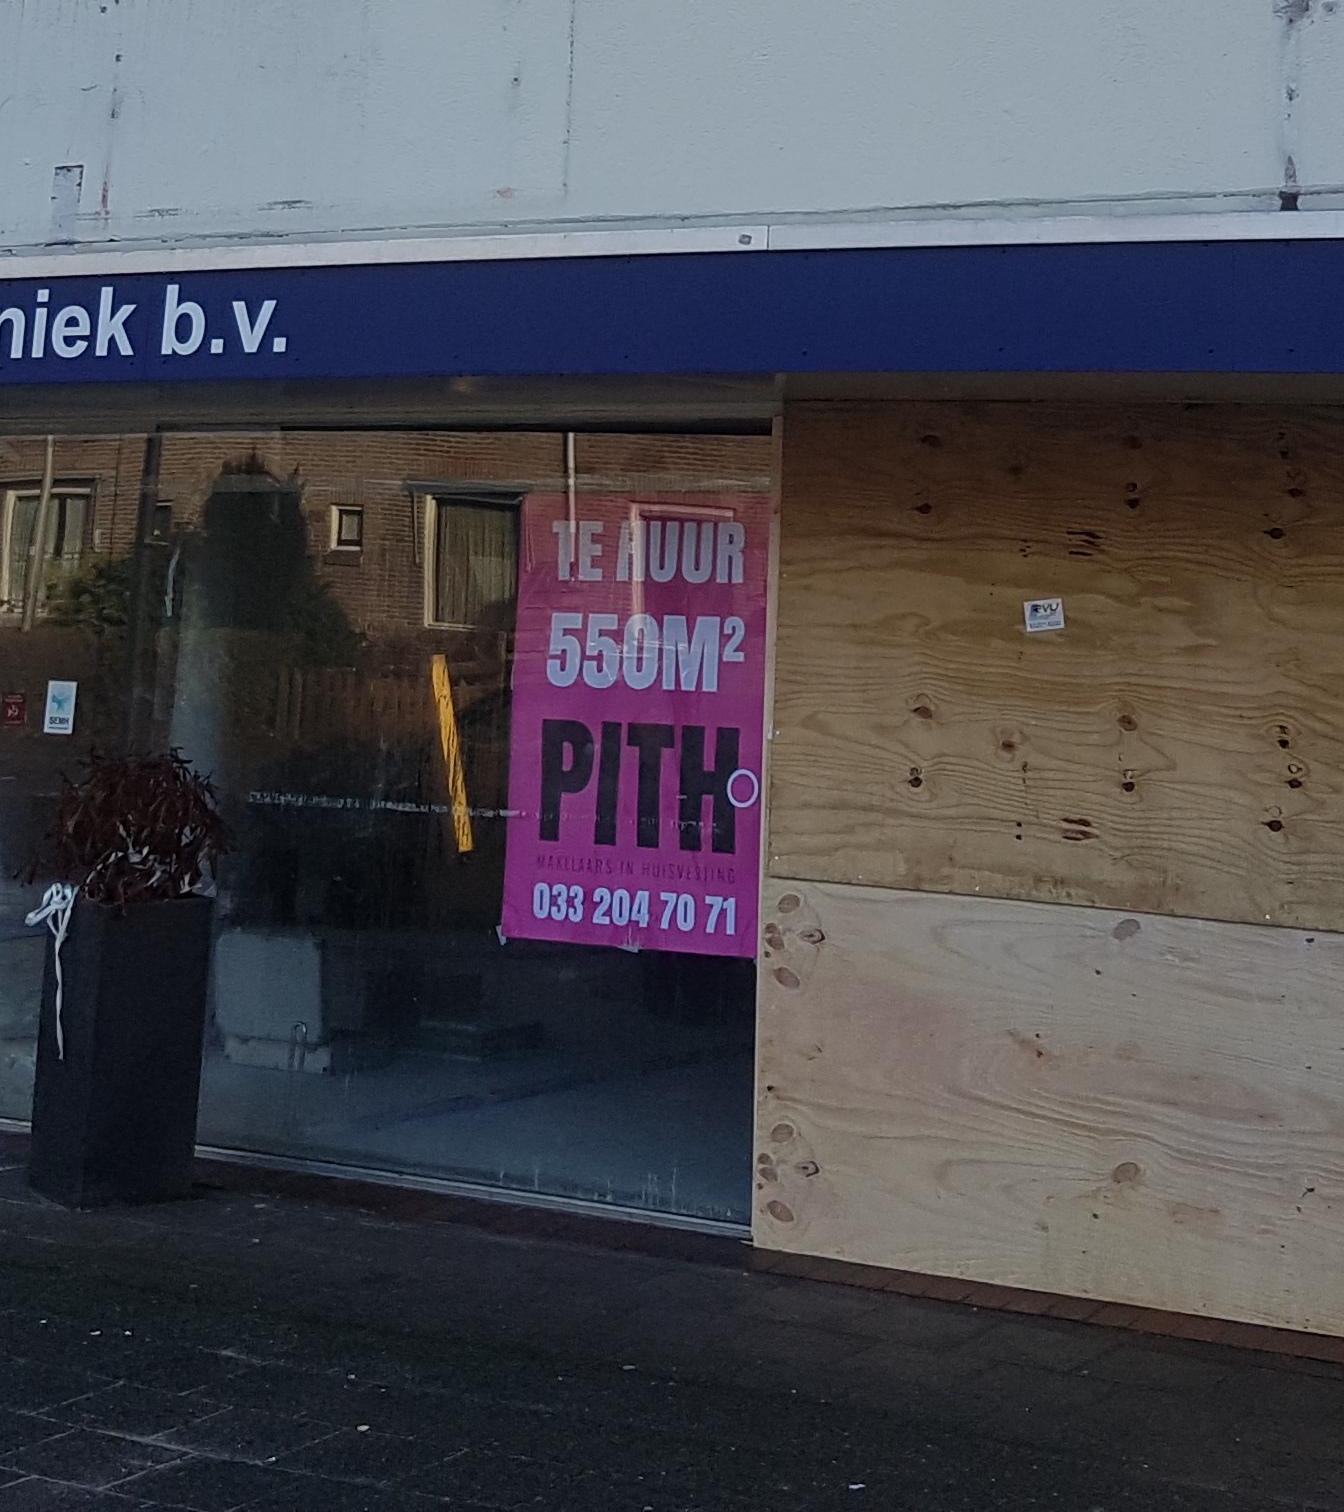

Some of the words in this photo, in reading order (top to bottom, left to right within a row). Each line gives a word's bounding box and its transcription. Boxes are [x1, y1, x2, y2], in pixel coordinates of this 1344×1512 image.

[159, 285, 289, 356] b.v.
[552, 520, 604, 582] TE
[616, 520, 746, 584] HUUR
[539, 718, 740, 855] PITH
[532, 882, 584, 923] 033
[592, 887, 650, 928] 204
[659, 892, 695, 932] 70
[705, 895, 736, 935] 71
